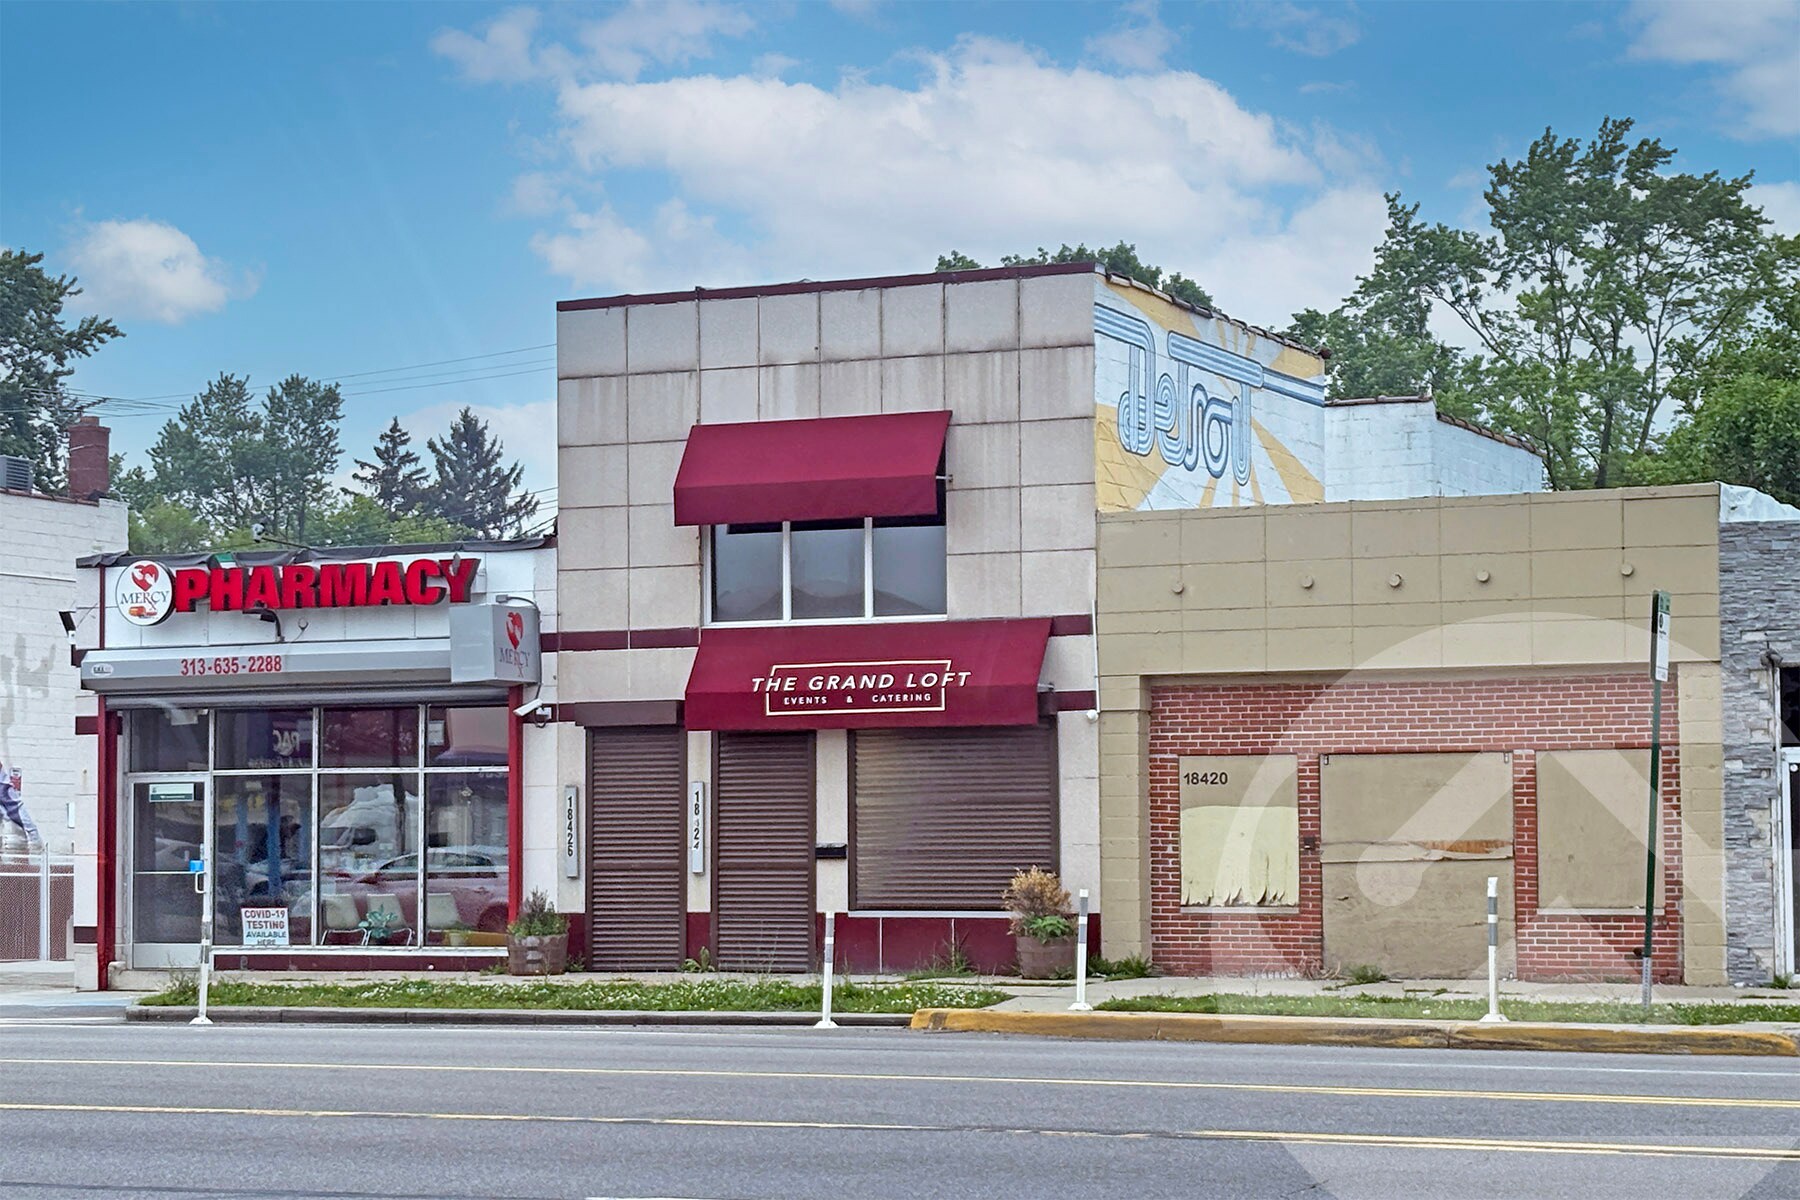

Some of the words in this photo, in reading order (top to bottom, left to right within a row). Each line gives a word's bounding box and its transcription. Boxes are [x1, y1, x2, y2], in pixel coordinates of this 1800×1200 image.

[176, 557, 481, 613] PHARMACY
[120, 590, 170, 611] MERCY
[181, 655, 282, 676] 313-635-2288
[752, 677, 797, 692] THE
[808, 674, 894, 691] GRAND
[906, 671, 971, 689] LOFT
[784, 696, 827, 705] EVENTS
[872, 693, 931, 703] CATERING
[1183, 772, 1228, 785] 18420
[244, 910, 286, 919] COVID-19
[247, 920, 285, 929] TESTING
